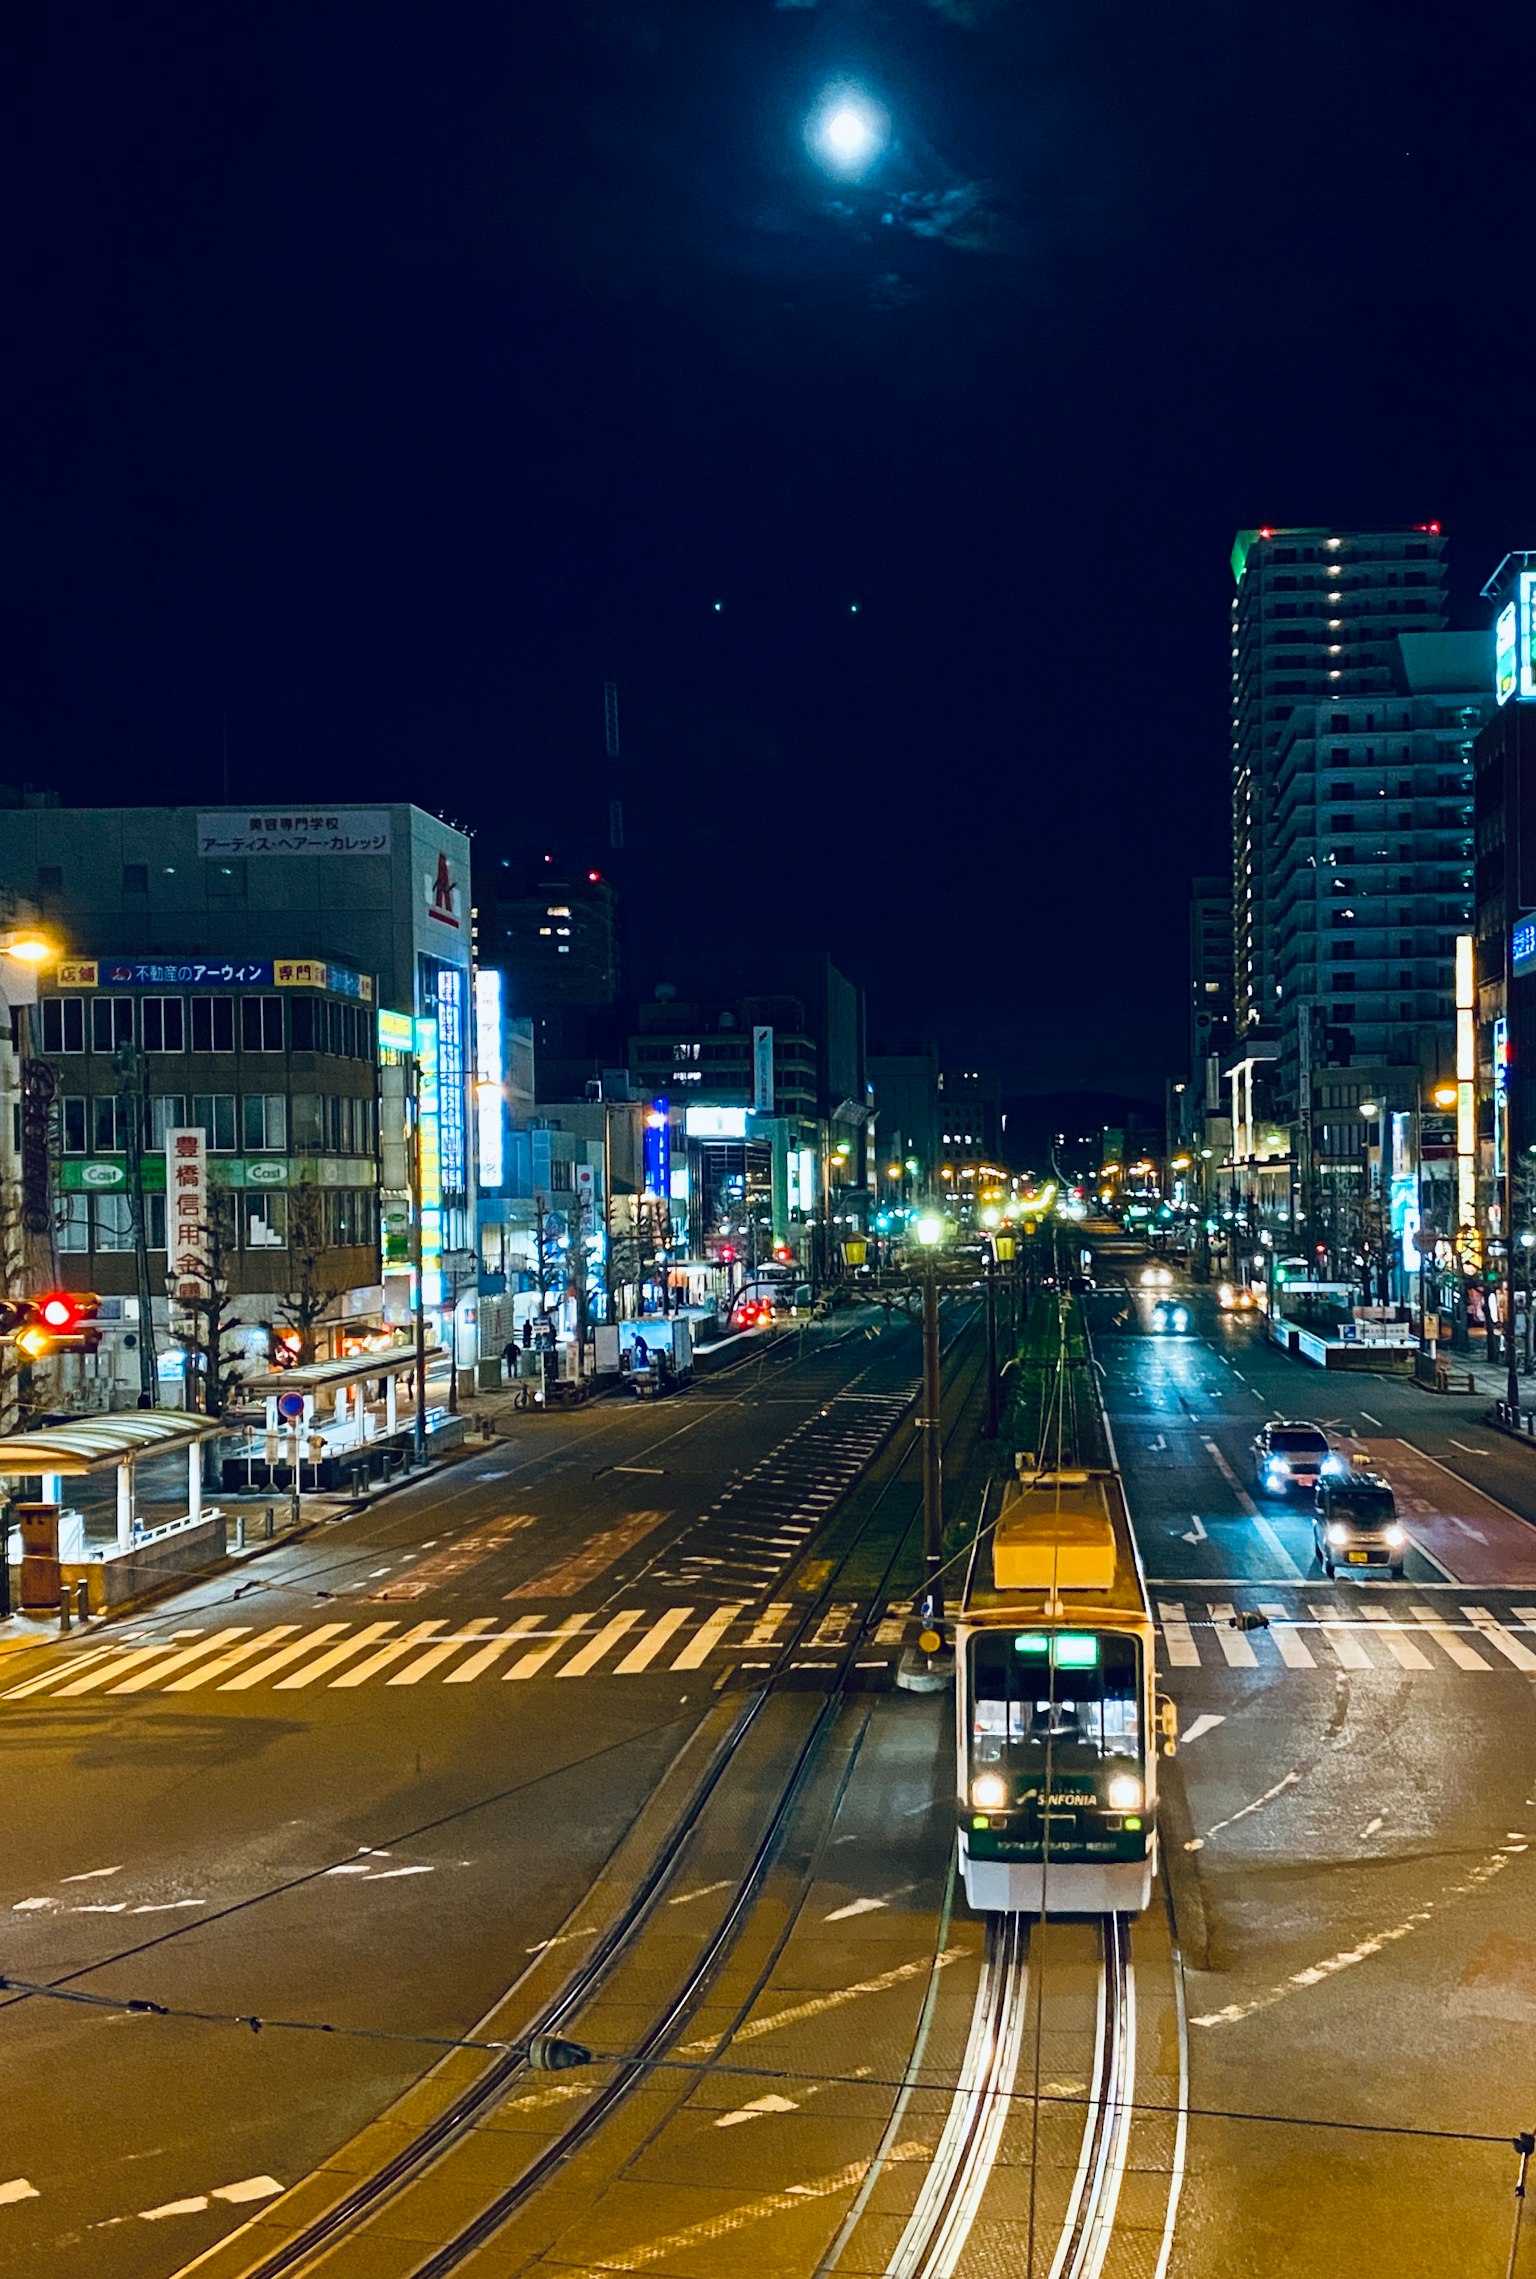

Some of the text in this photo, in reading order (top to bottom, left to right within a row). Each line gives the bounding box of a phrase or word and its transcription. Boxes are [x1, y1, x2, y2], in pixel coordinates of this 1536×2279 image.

[250, 817, 339, 831] 美容専門学校
[61, 966, 95, 982] 店舗
[135, 965, 262, 982] 不動産のアーウィン
[279, 965, 311, 981] 専門
[88, 1168, 117, 1181] Cast
[252, 1166, 281, 1179] Cast
